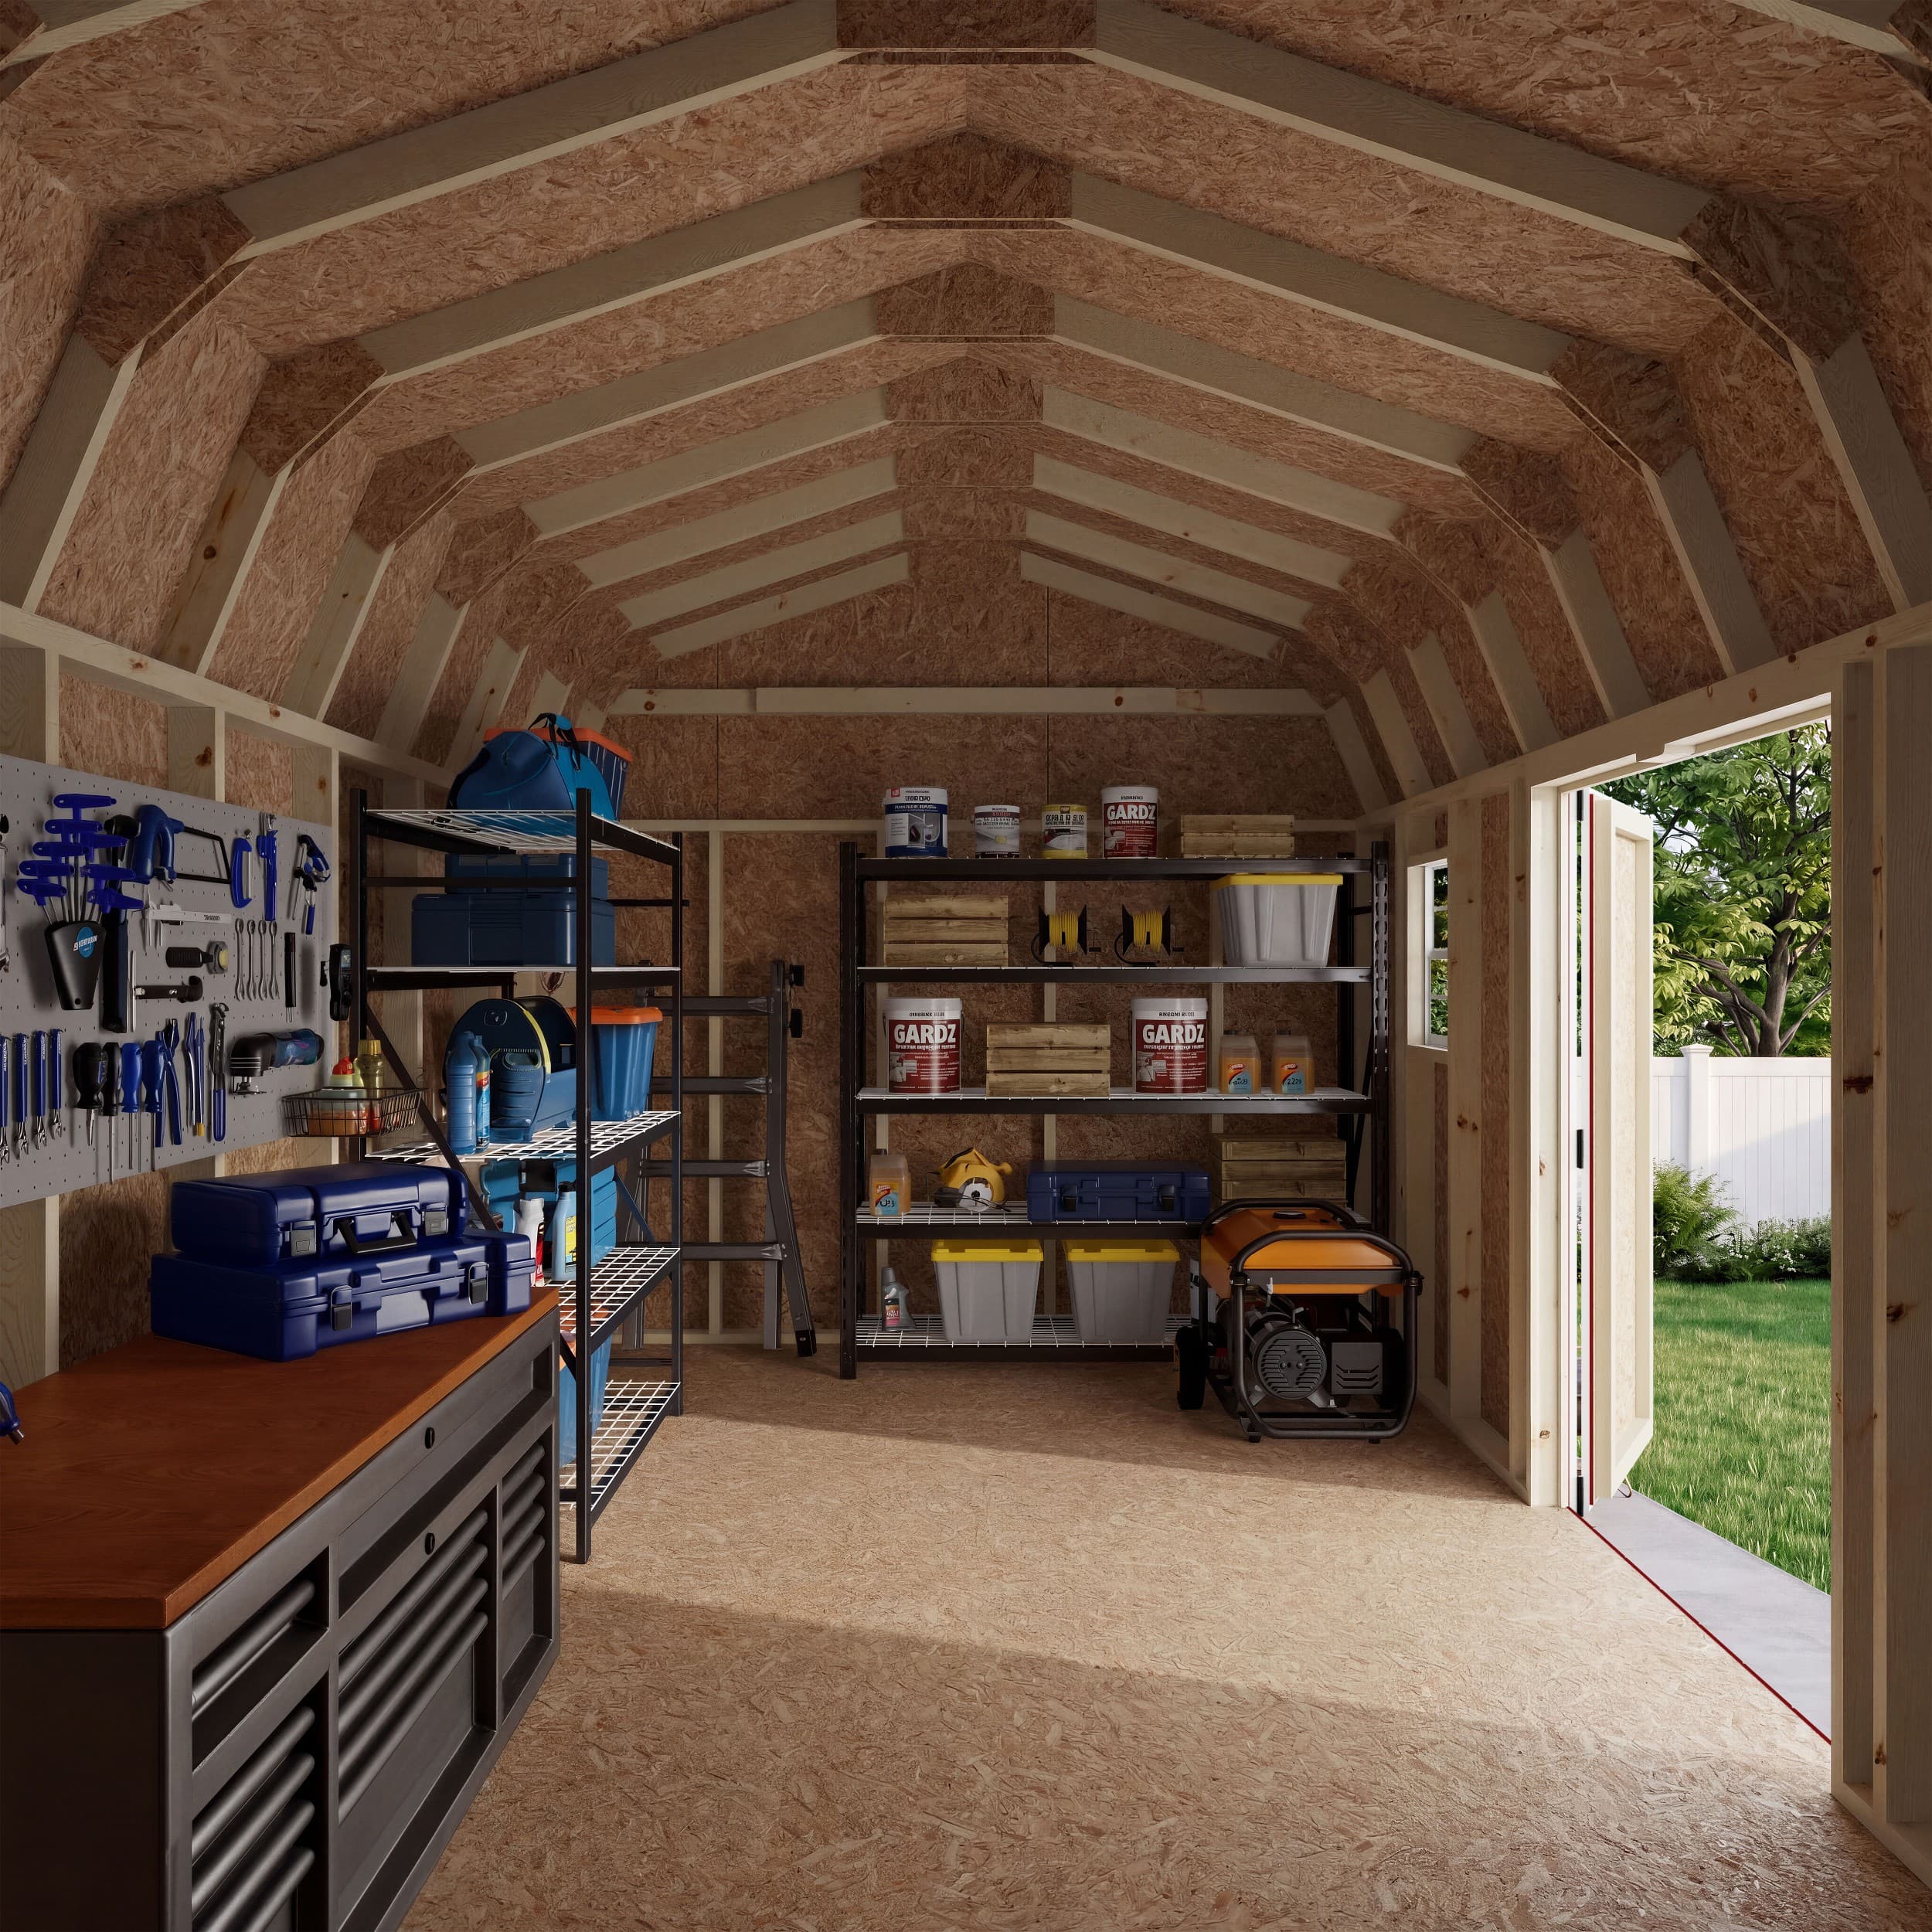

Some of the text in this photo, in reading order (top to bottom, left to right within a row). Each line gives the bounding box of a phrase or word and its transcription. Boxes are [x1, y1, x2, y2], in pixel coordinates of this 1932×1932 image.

[1107, 804, 1156, 820] GARDZ
[894, 1024, 957, 1044] GARDZ
[1142, 1024, 1205, 1044] GARDZ
